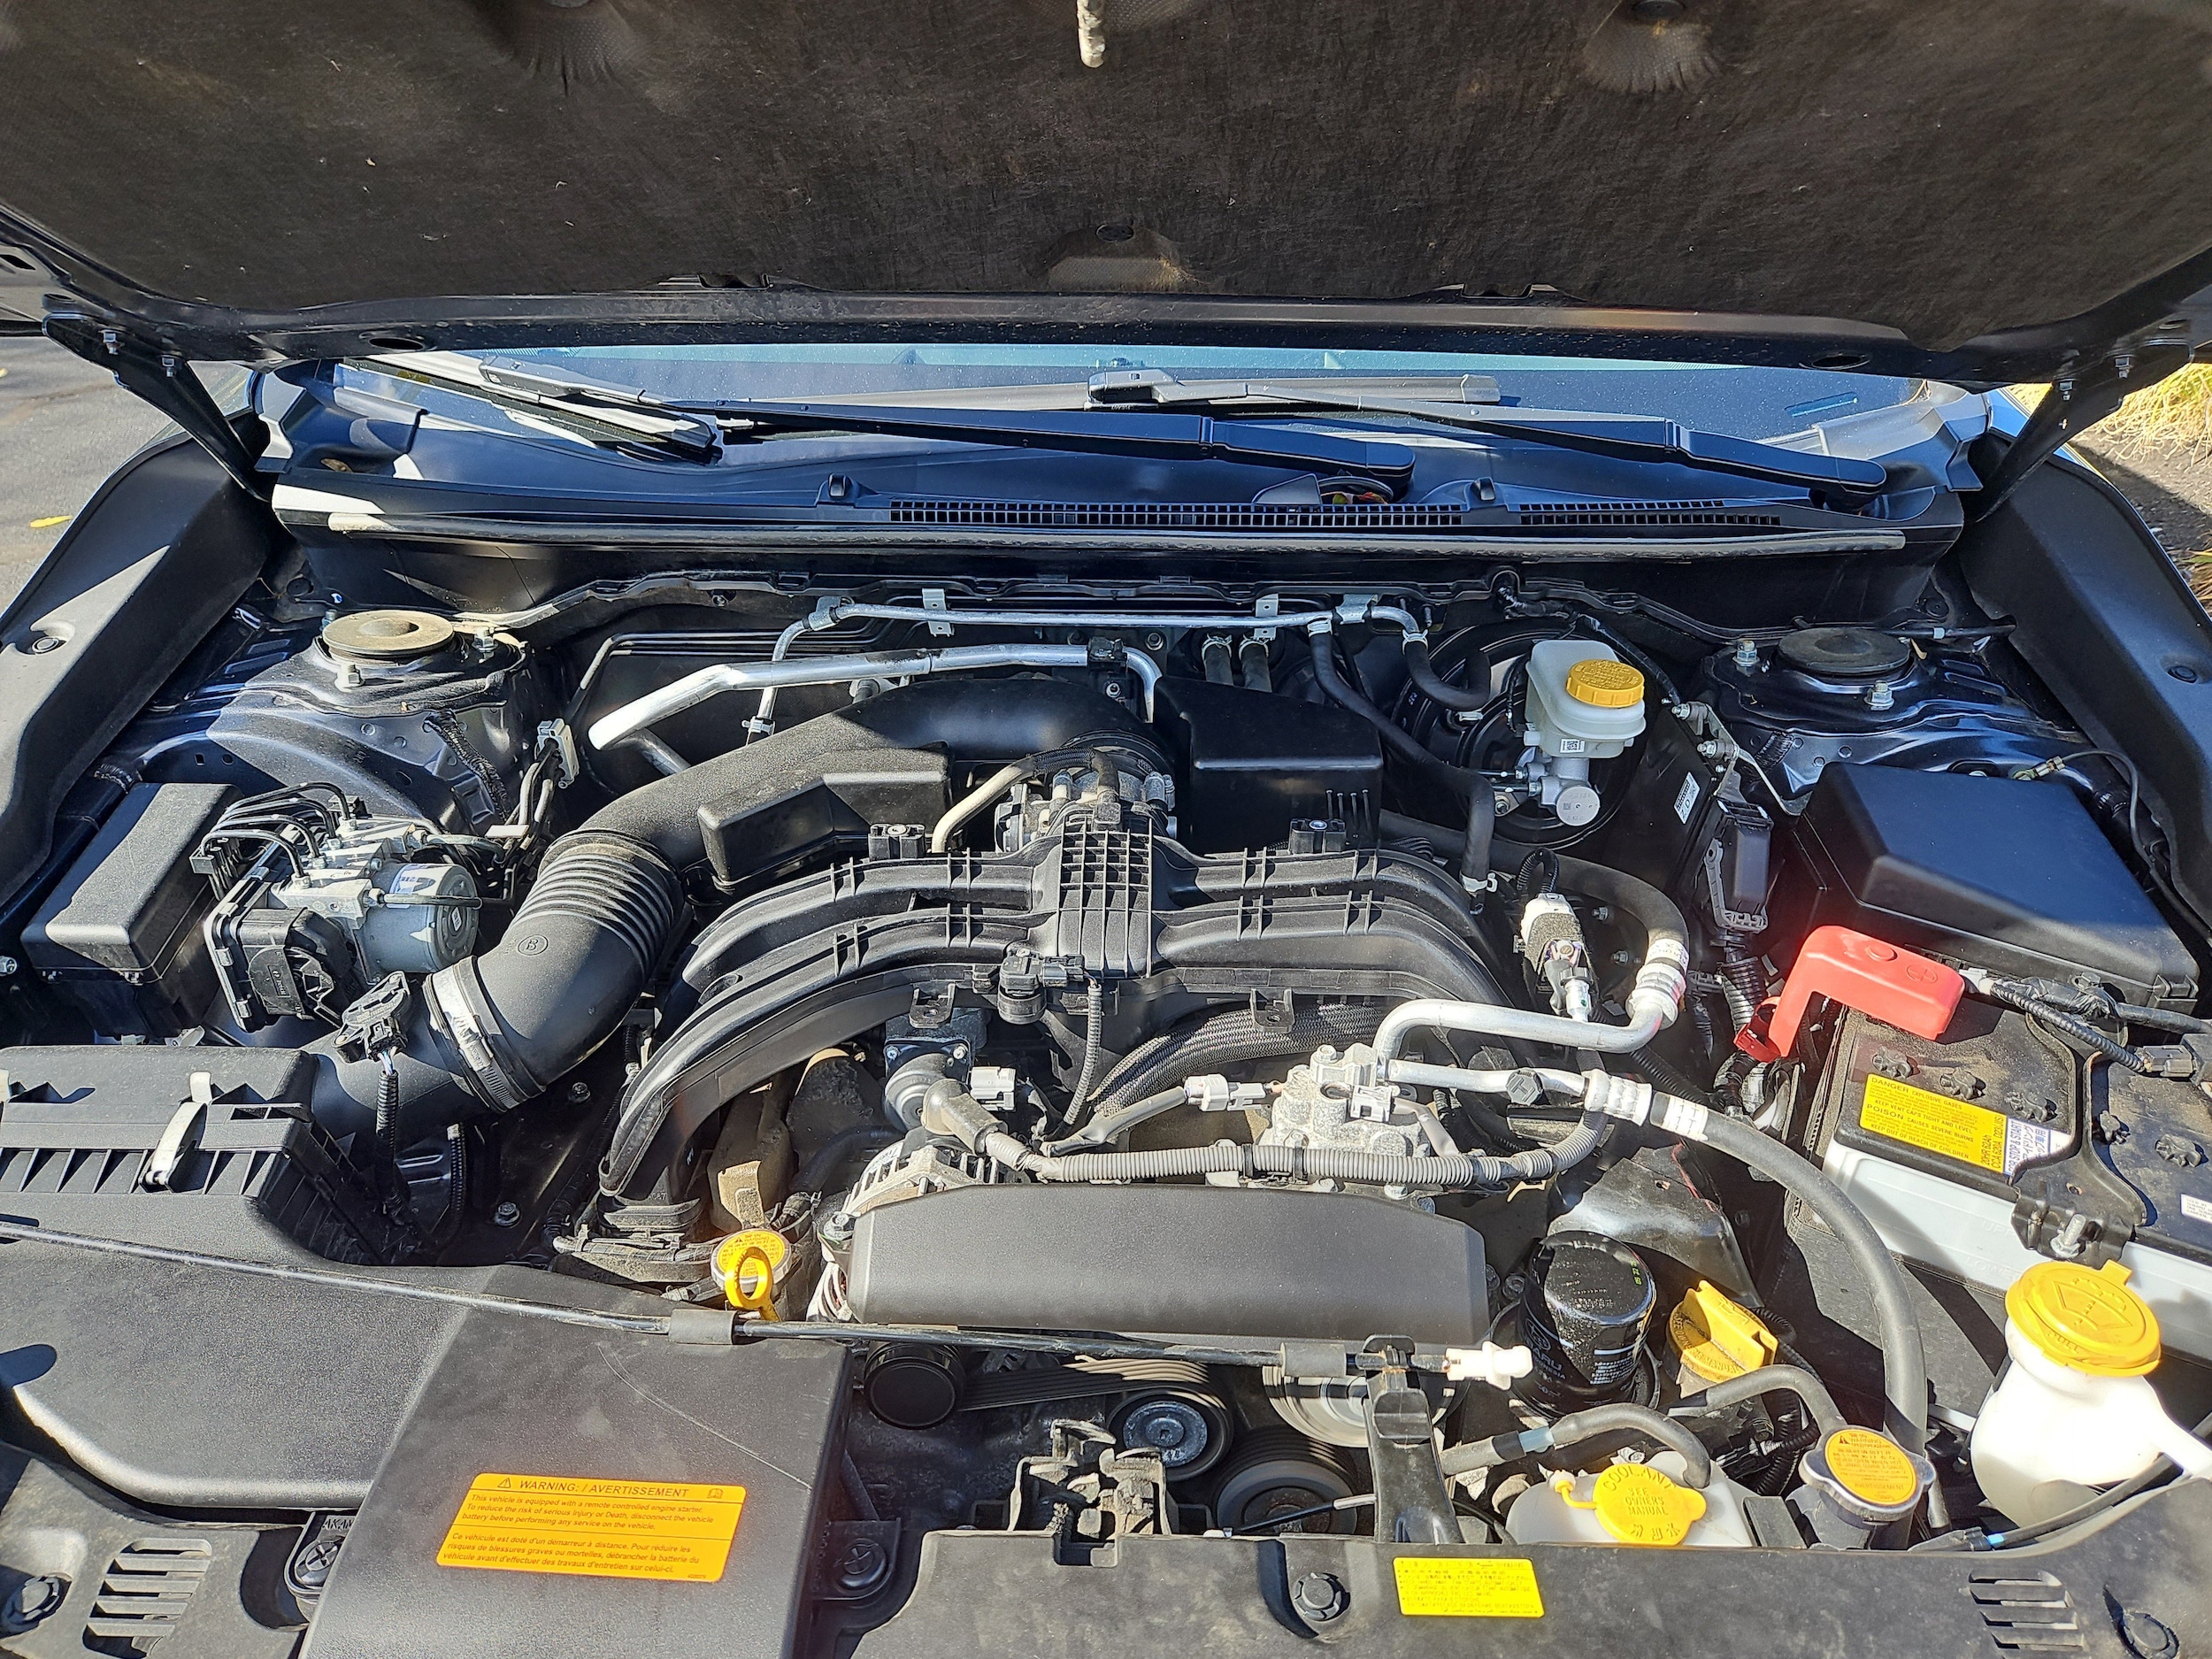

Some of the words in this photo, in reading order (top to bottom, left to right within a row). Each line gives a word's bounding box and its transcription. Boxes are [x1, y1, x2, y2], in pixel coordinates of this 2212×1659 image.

[1871, 1077, 1909, 1093] DANGER
[1911, 1090, 1941, 1103] EXPLOSIVE
[1944, 1099, 1962, 1110] GASES
[1867, 1103, 1904, 1120] POISON
[1876, 1099, 1888, 1108] KEEP
[1890, 1103, 1904, 1112] VENT
[1907, 1108, 1921, 1118] CAPS
[1924, 1113, 1940, 1124] TIGHT
[1941, 1118, 1954, 1128] AND
[1955, 1123, 1973, 1133] LEVEL
[1907, 1116, 1929, 1128] CAUSES
[1931, 1124, 1952, 1136] SEVERE
[1954, 1132, 1974, 1142] BURNS
[2010, 1120, 2022, 1139] START
[1870, 1124, 1886, 1133] KEEP
[1886, 1127, 1898, 1136] OUT
[1909, 1134, 1928, 1146] REACH
[1939, 1145, 1969, 1159] CHILDREN
[1991, 1153, 2001, 1169] CCA
[2009, 1145, 2020, 1160] STOP
[2047, 1331, 2079, 1355] PULL
[1704, 1356, 1740, 1375] MANUAL
[1603, 1465, 1677, 1491] COOLANT
[520, 1480, 579, 1492] WARNING:
[588, 1485, 689, 1497] AVERTISSEMENT
[1628, 1487, 1647, 1496] SEE
[1625, 1496, 1664, 1506] OWNERS
[573, 1509, 595, 1518] Injury
[1628, 1506, 1669, 1515] MANUAL
[499, 1555, 540, 1564] d'effectuer
[588, 1561, 628, 1570] d'entretien
[566, 1549, 603, 1559] mortelles,
